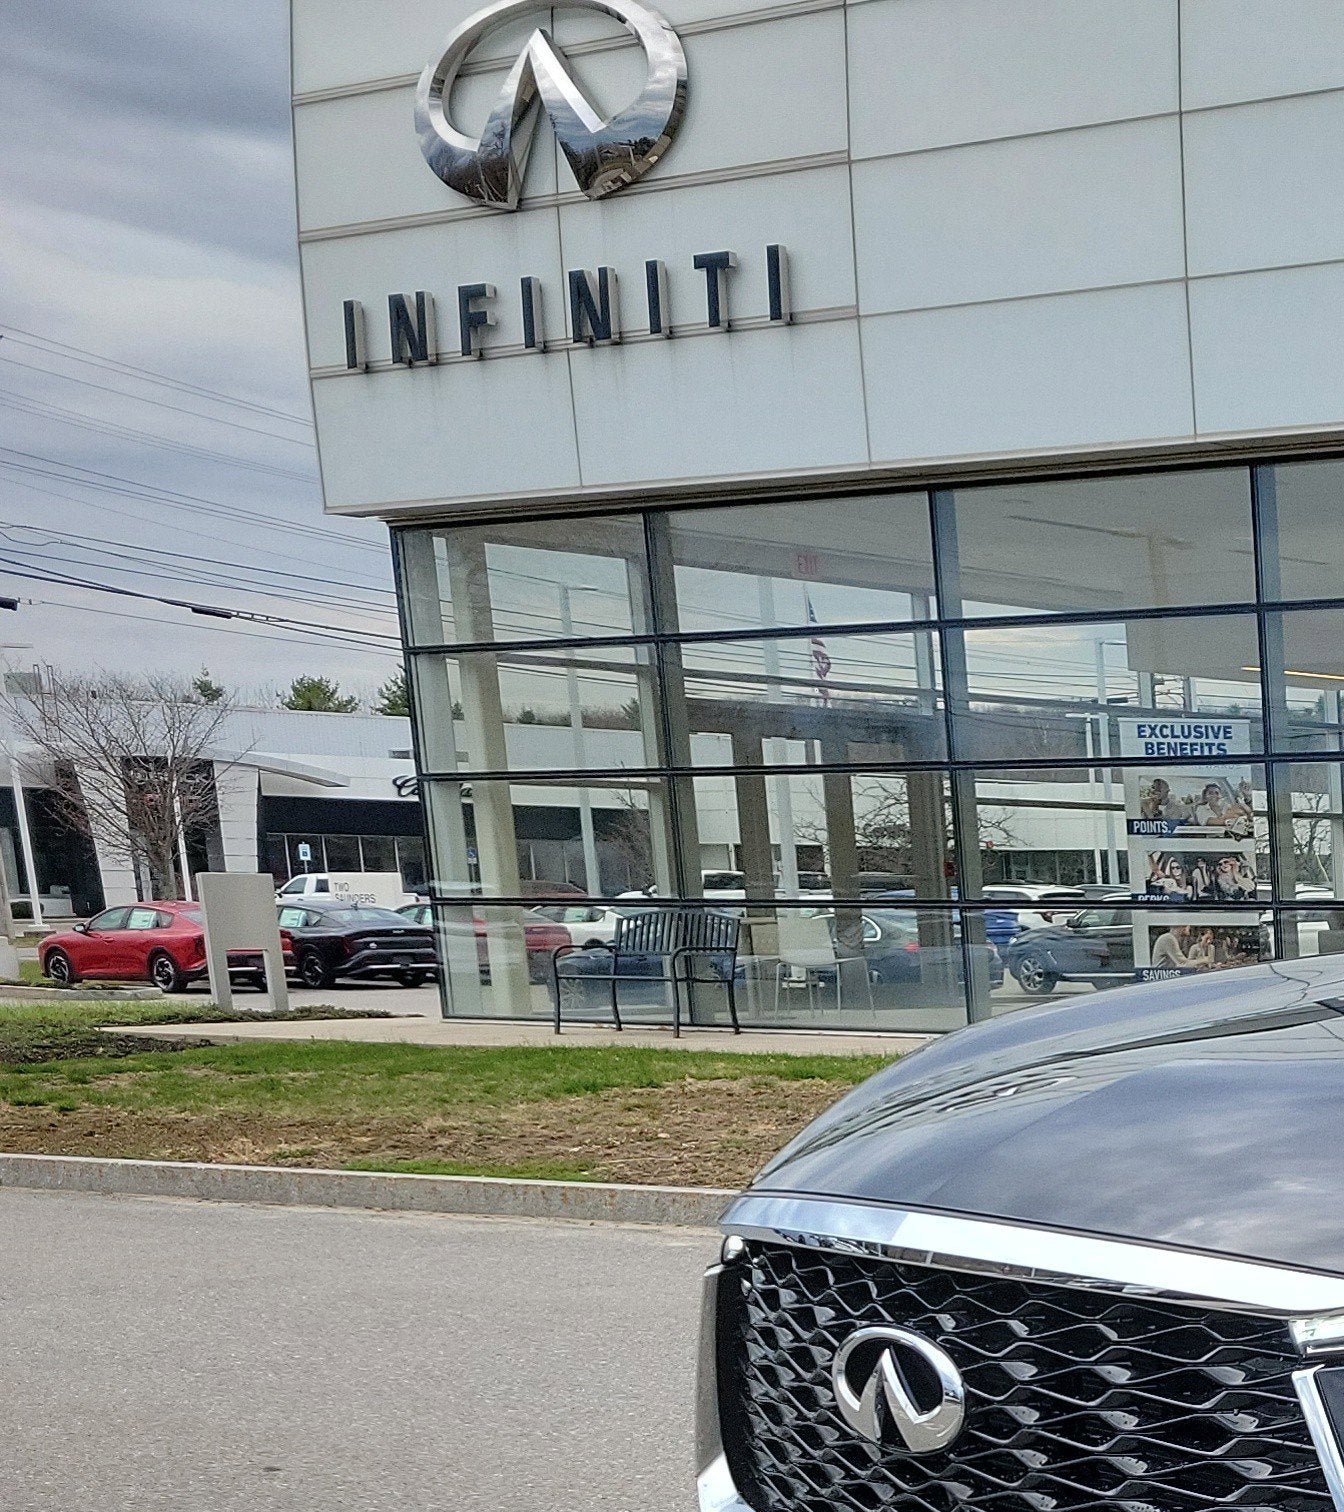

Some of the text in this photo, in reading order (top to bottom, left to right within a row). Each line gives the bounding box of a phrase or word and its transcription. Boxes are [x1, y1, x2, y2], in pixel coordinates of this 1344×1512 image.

[342, 244, 790, 370] INFINITI
[1137, 724, 1233, 740] EXCLUSIVE
[1144, 741, 1228, 756] BENEFITS
[1133, 820, 1171, 834] POINTS.
[334, 882, 350, 892] TWO
